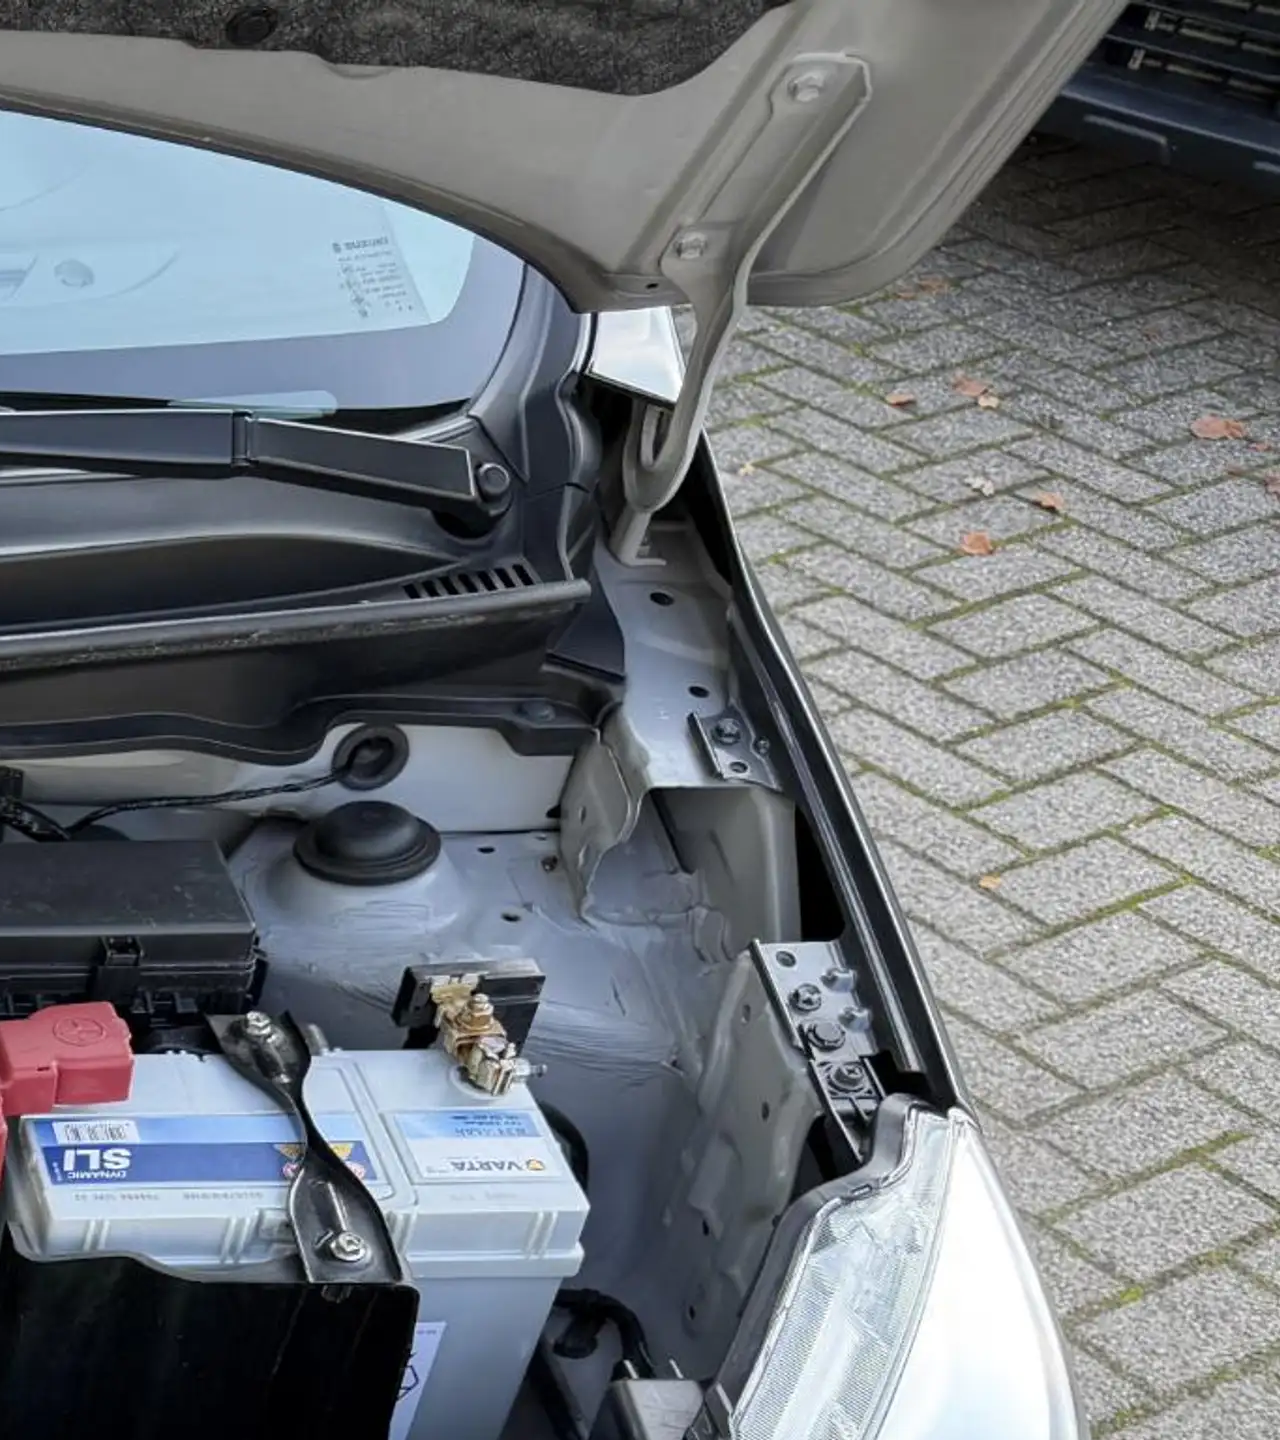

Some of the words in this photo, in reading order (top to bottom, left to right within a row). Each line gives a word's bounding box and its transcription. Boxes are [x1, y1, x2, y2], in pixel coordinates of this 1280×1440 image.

[64, 1149, 131, 1172] SLI
[450, 1160, 523, 1171] VARTA
[68, 1171, 127, 1179] DYNAMIC
